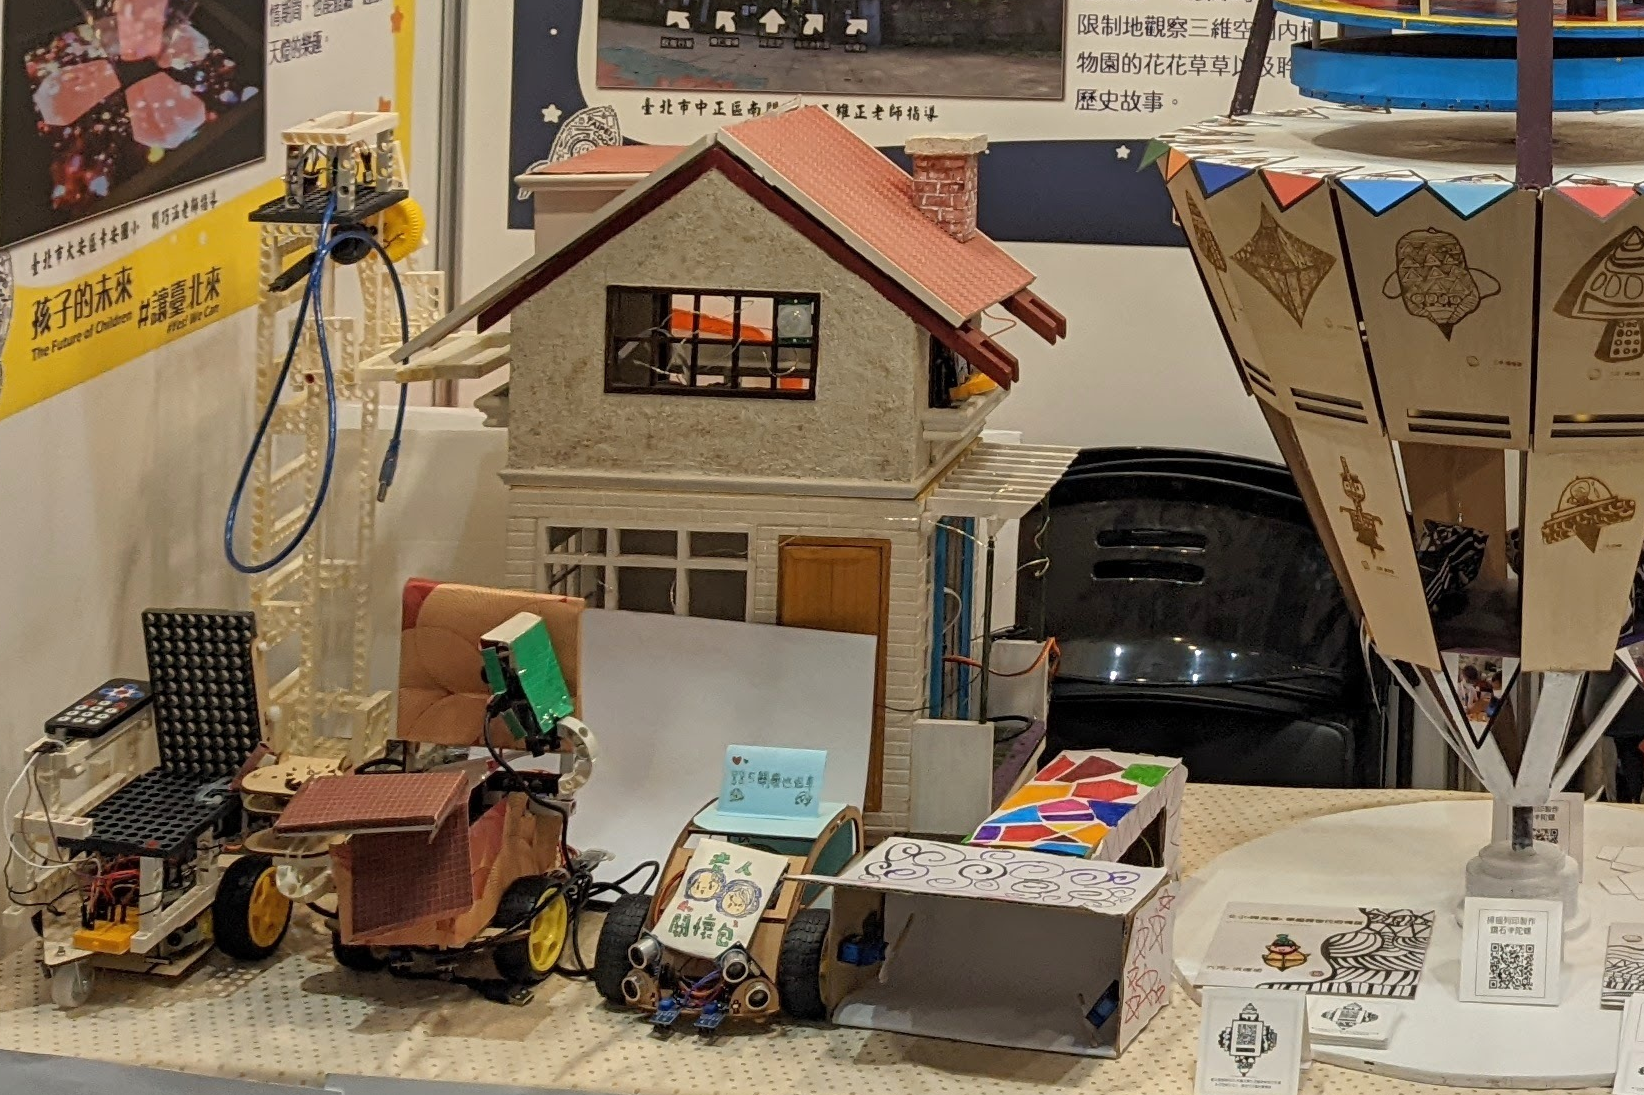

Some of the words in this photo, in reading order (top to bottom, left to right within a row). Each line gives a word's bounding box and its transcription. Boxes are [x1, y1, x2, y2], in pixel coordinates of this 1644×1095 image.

[31, 265, 133, 340] 孩子的未來
[51, 333, 82, 352] Future
[95, 311, 133, 334] Children
